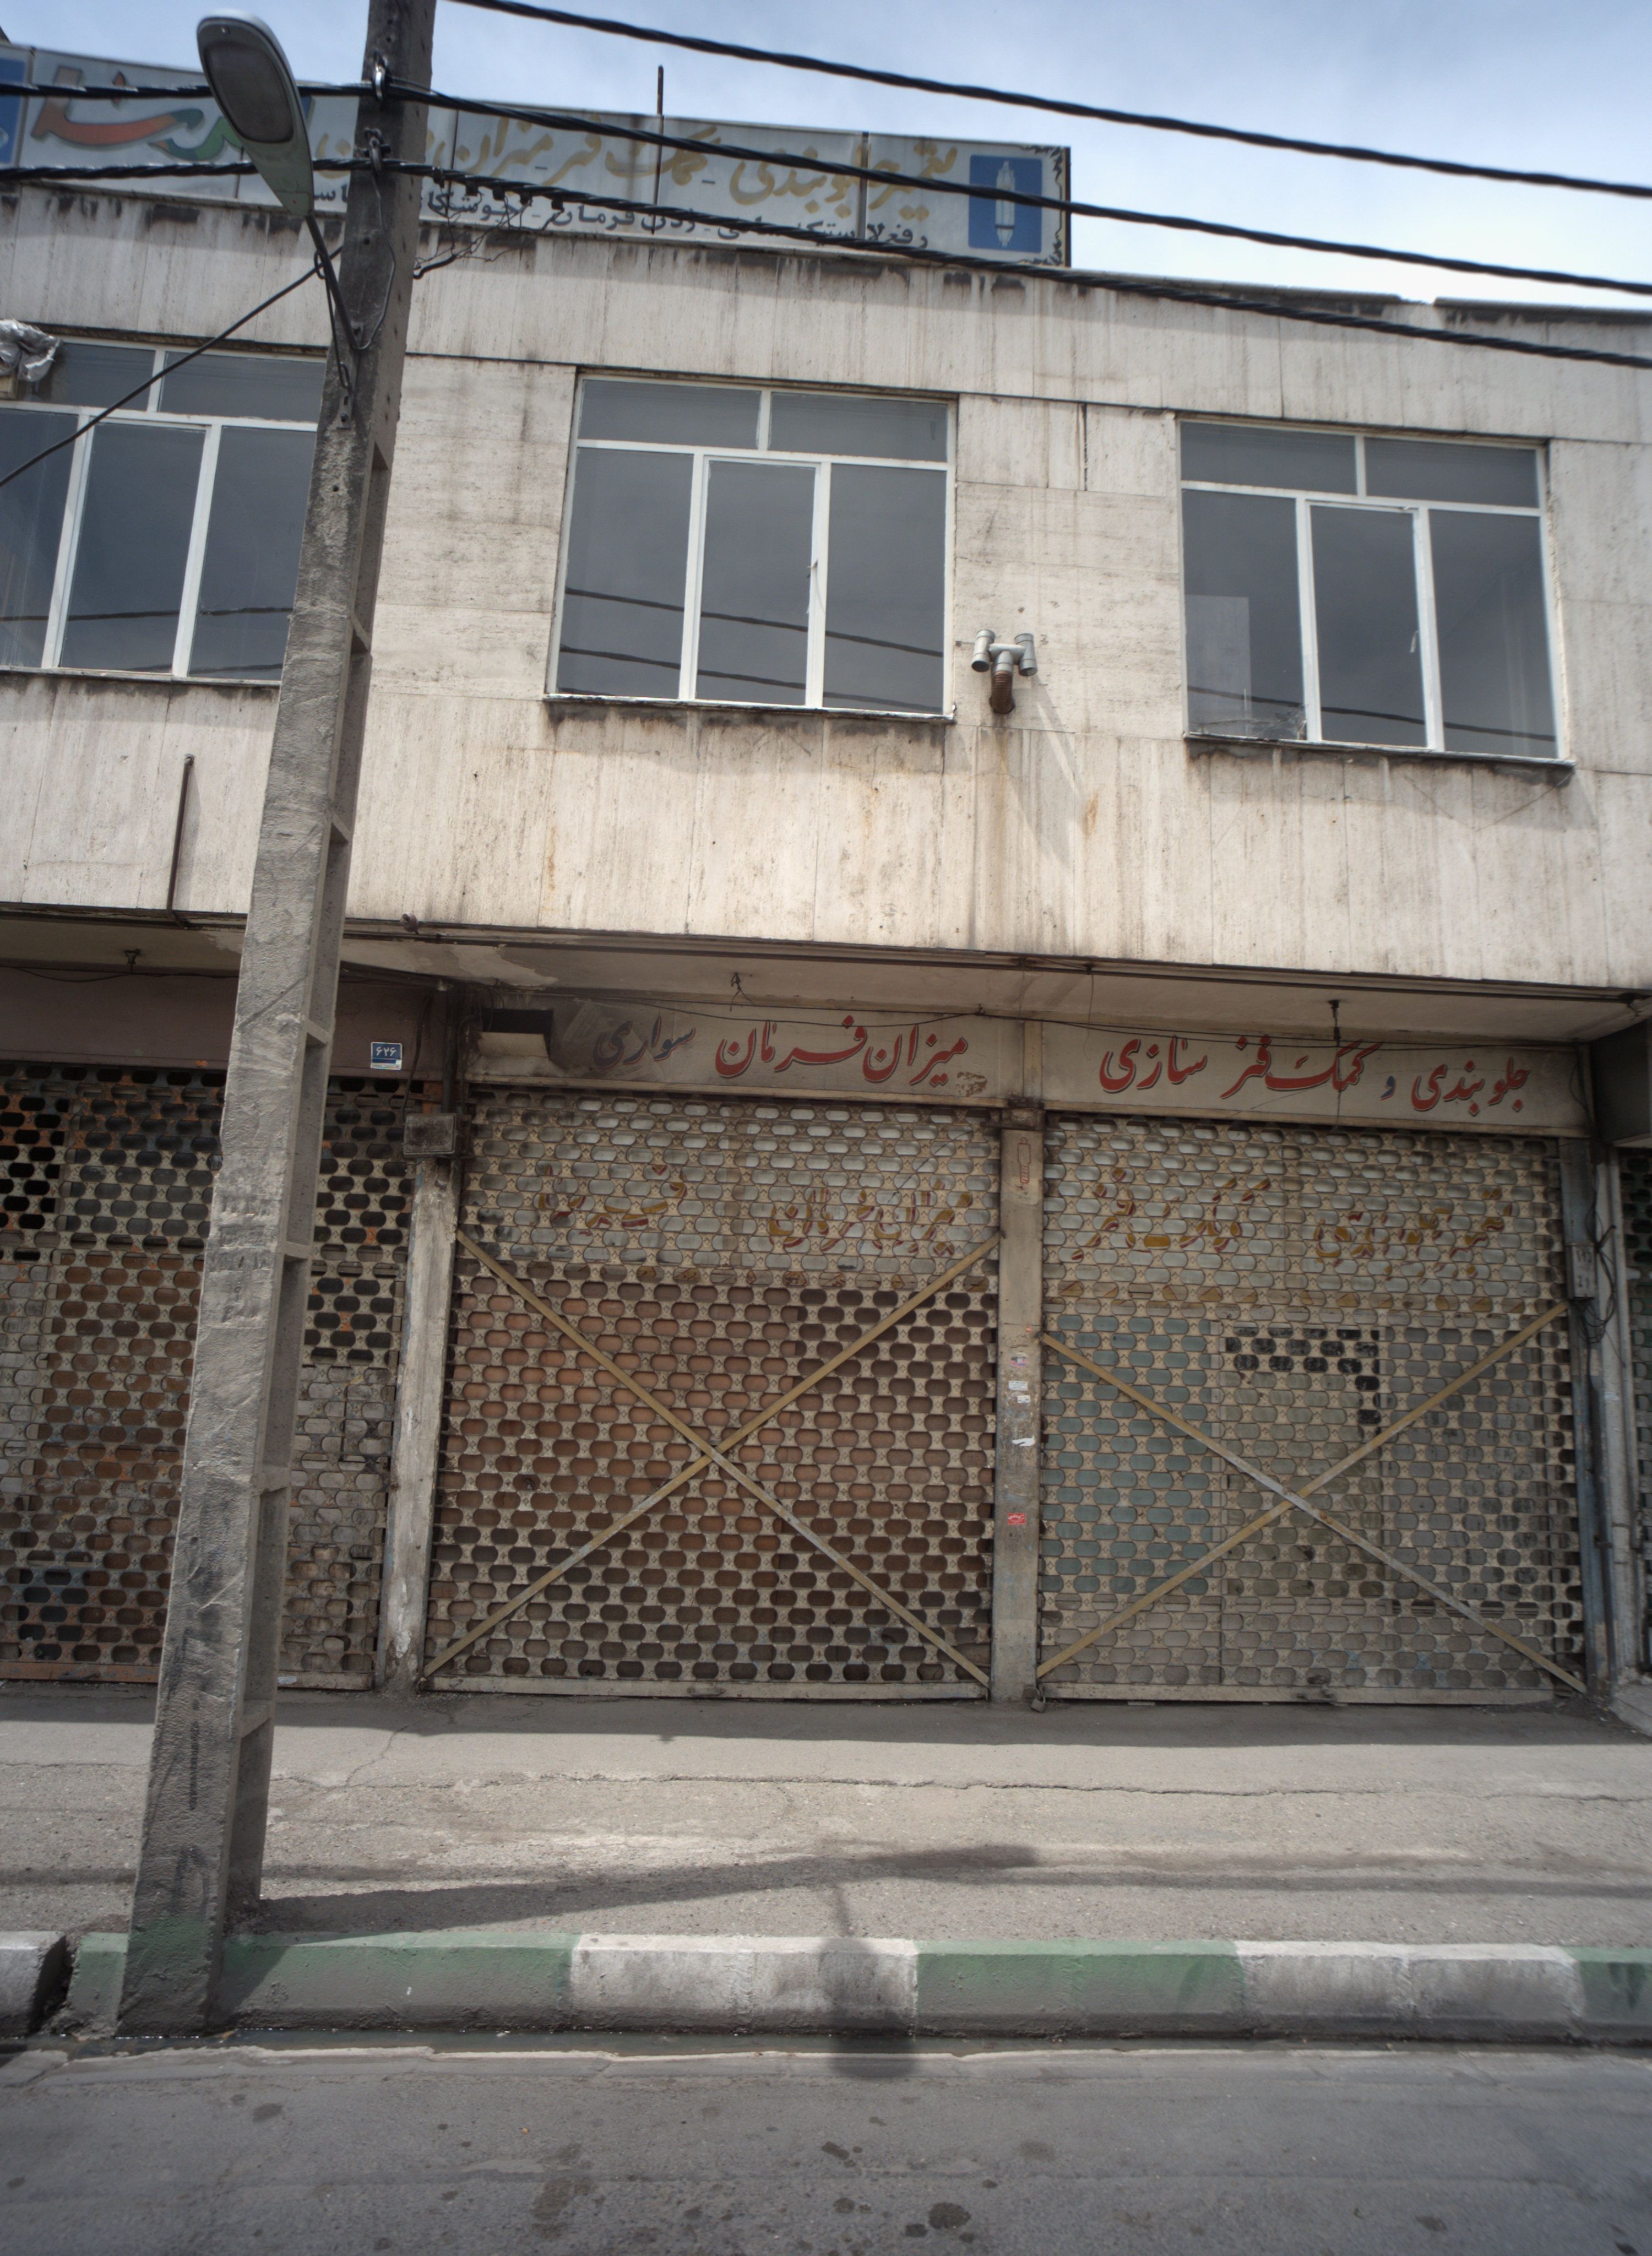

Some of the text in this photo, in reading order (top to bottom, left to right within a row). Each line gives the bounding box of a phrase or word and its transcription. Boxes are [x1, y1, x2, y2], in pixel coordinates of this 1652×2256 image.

[593, 1014, 969, 1088] میزان فرمان سواری
[1098, 1034, 1208, 1094] سازی
[1219, 1033, 1273, 1100] فنر
[1264, 1038, 1384, 1092] کمک
[1380, 1075, 1397, 1102] و
